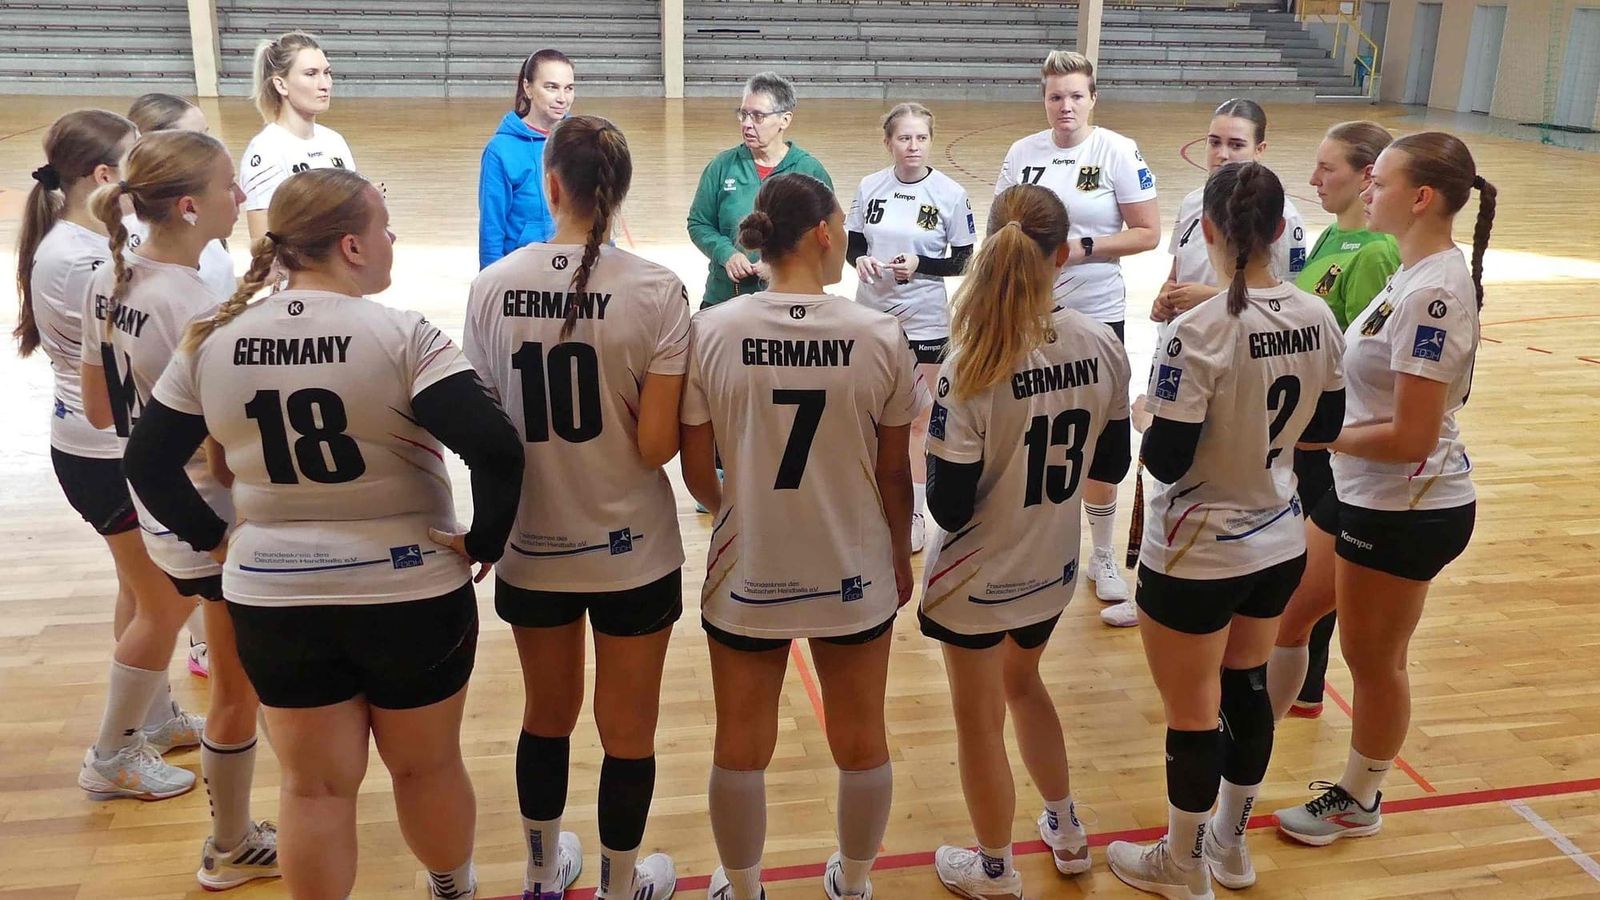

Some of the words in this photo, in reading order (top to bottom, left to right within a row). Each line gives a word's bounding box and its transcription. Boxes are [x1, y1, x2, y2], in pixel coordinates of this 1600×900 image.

[1021, 166, 1046, 185] 17
[865, 198, 888, 225] 15
[894, 192, 916, 201] Kempa
[1340, 242, 1361, 250] Kempa
[233, 335, 353, 366] GERMANY
[741, 337, 855, 367] GERMANY
[918, 344, 941, 352] Kempa
[1249, 324, 1321, 360] GERMANY
[511, 341, 603, 444] 10
[1011, 357, 1099, 400] GERMANY
[244, 387, 367, 485] 18
[772, 388, 827, 490] 7
[1265, 374, 1301, 470] 2
[1023, 408, 1091, 508] 13
[1340, 529, 1373, 550] Kempa
[1235, 796, 1254, 836] Kempa
[1192, 823, 1206, 859] Kempa
